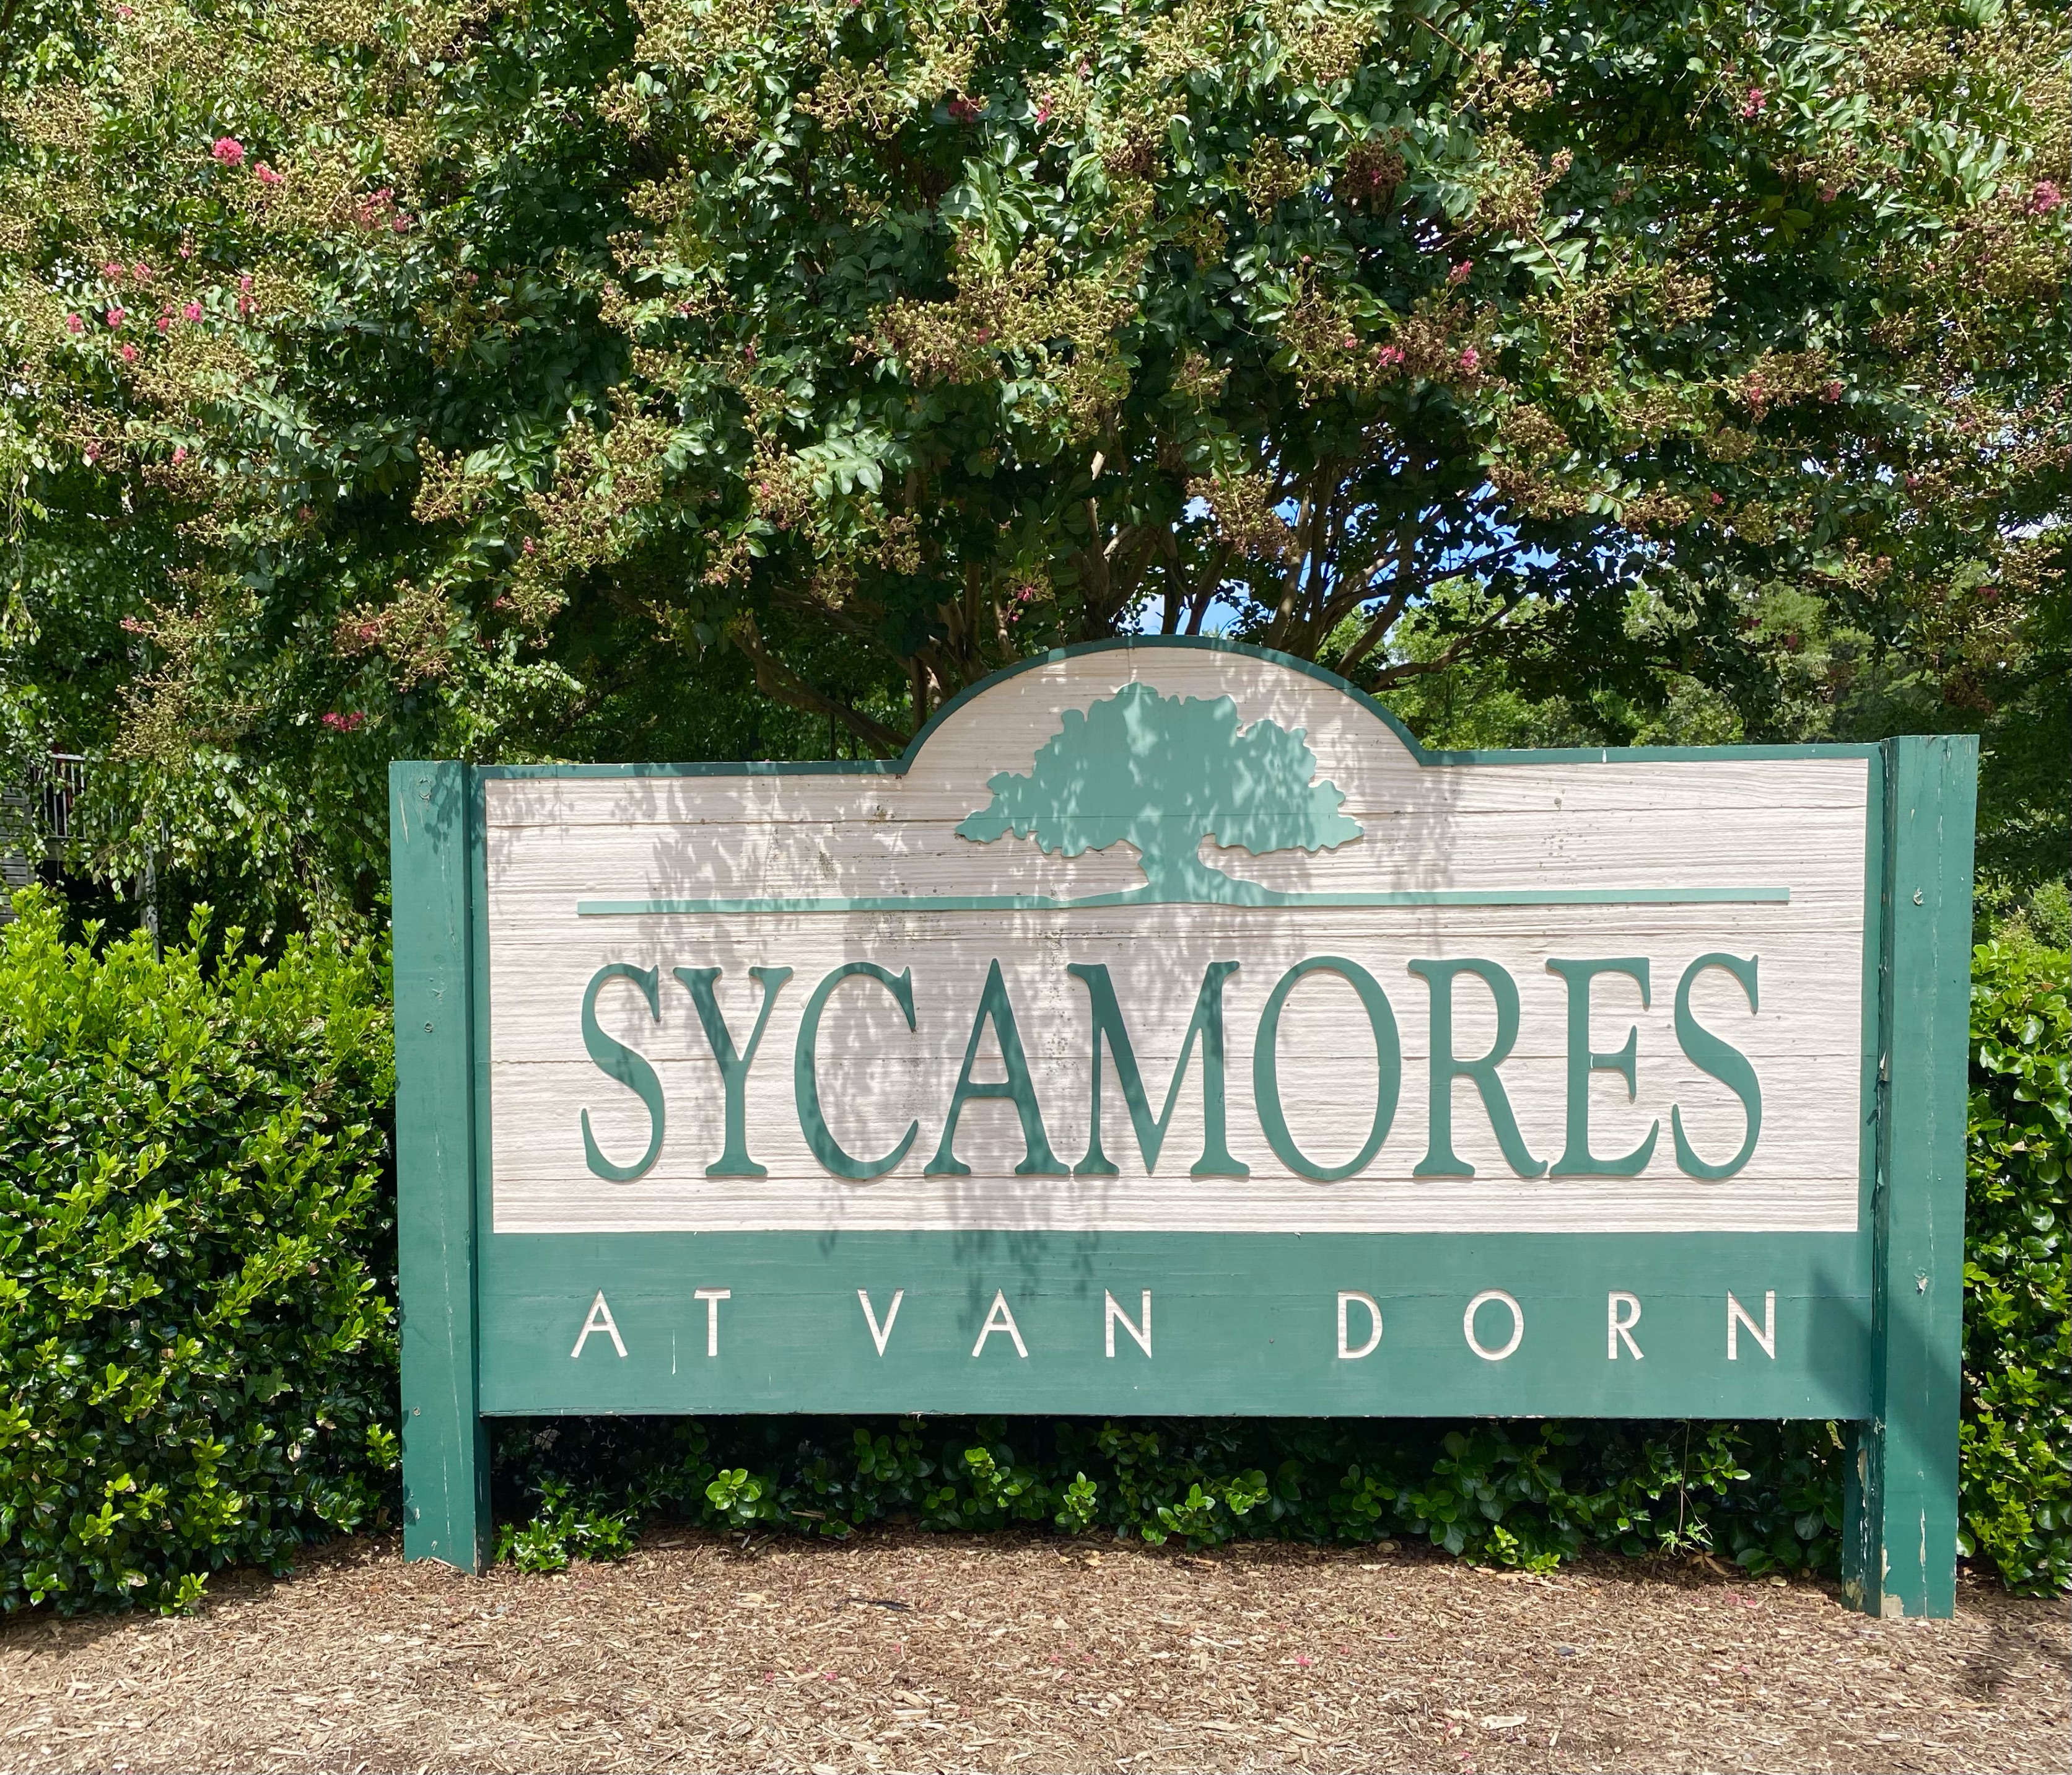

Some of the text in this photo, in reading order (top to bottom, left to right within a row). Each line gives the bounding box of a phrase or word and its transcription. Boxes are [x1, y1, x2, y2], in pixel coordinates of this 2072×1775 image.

[581, 953, 1762, 1182] SYCAMORES
[570, 1289, 1777, 1361] AT VAN DORN
